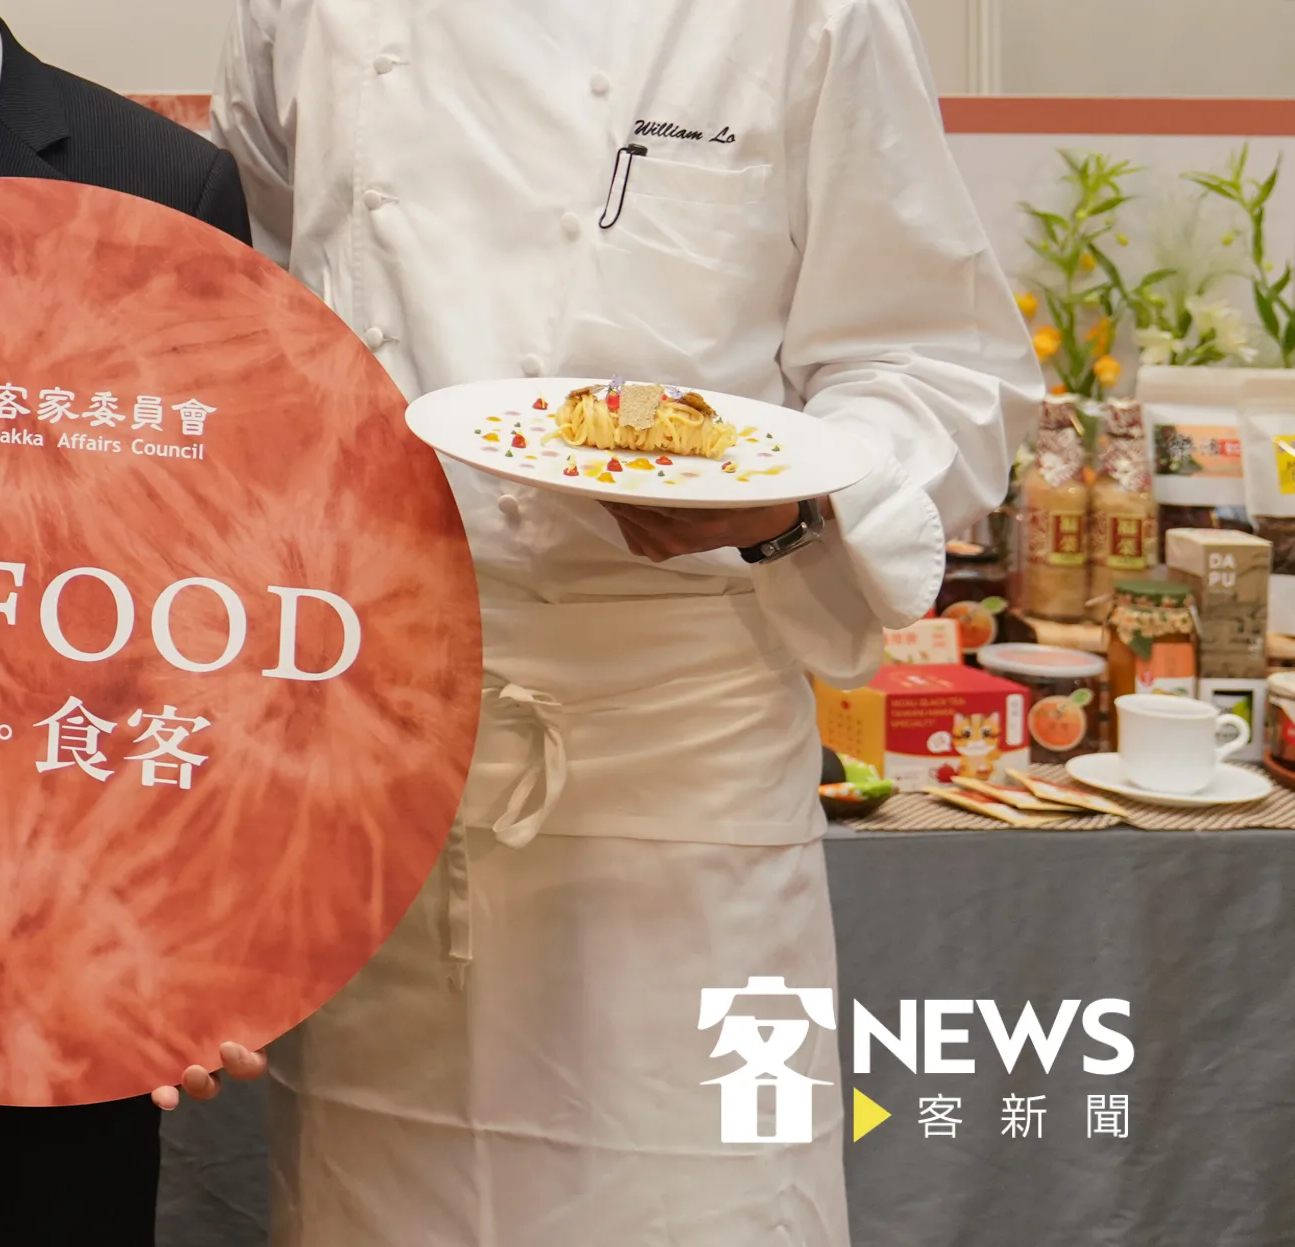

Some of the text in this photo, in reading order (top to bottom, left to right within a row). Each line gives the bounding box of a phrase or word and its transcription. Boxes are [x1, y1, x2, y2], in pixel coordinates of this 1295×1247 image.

[634, 119, 737, 144] William Lo
[56, 432, 122, 454] Affairs
[130, 438, 205, 460] Council
[1208, 552, 1237, 569] DA
[1208, 571, 1237, 588] PU
